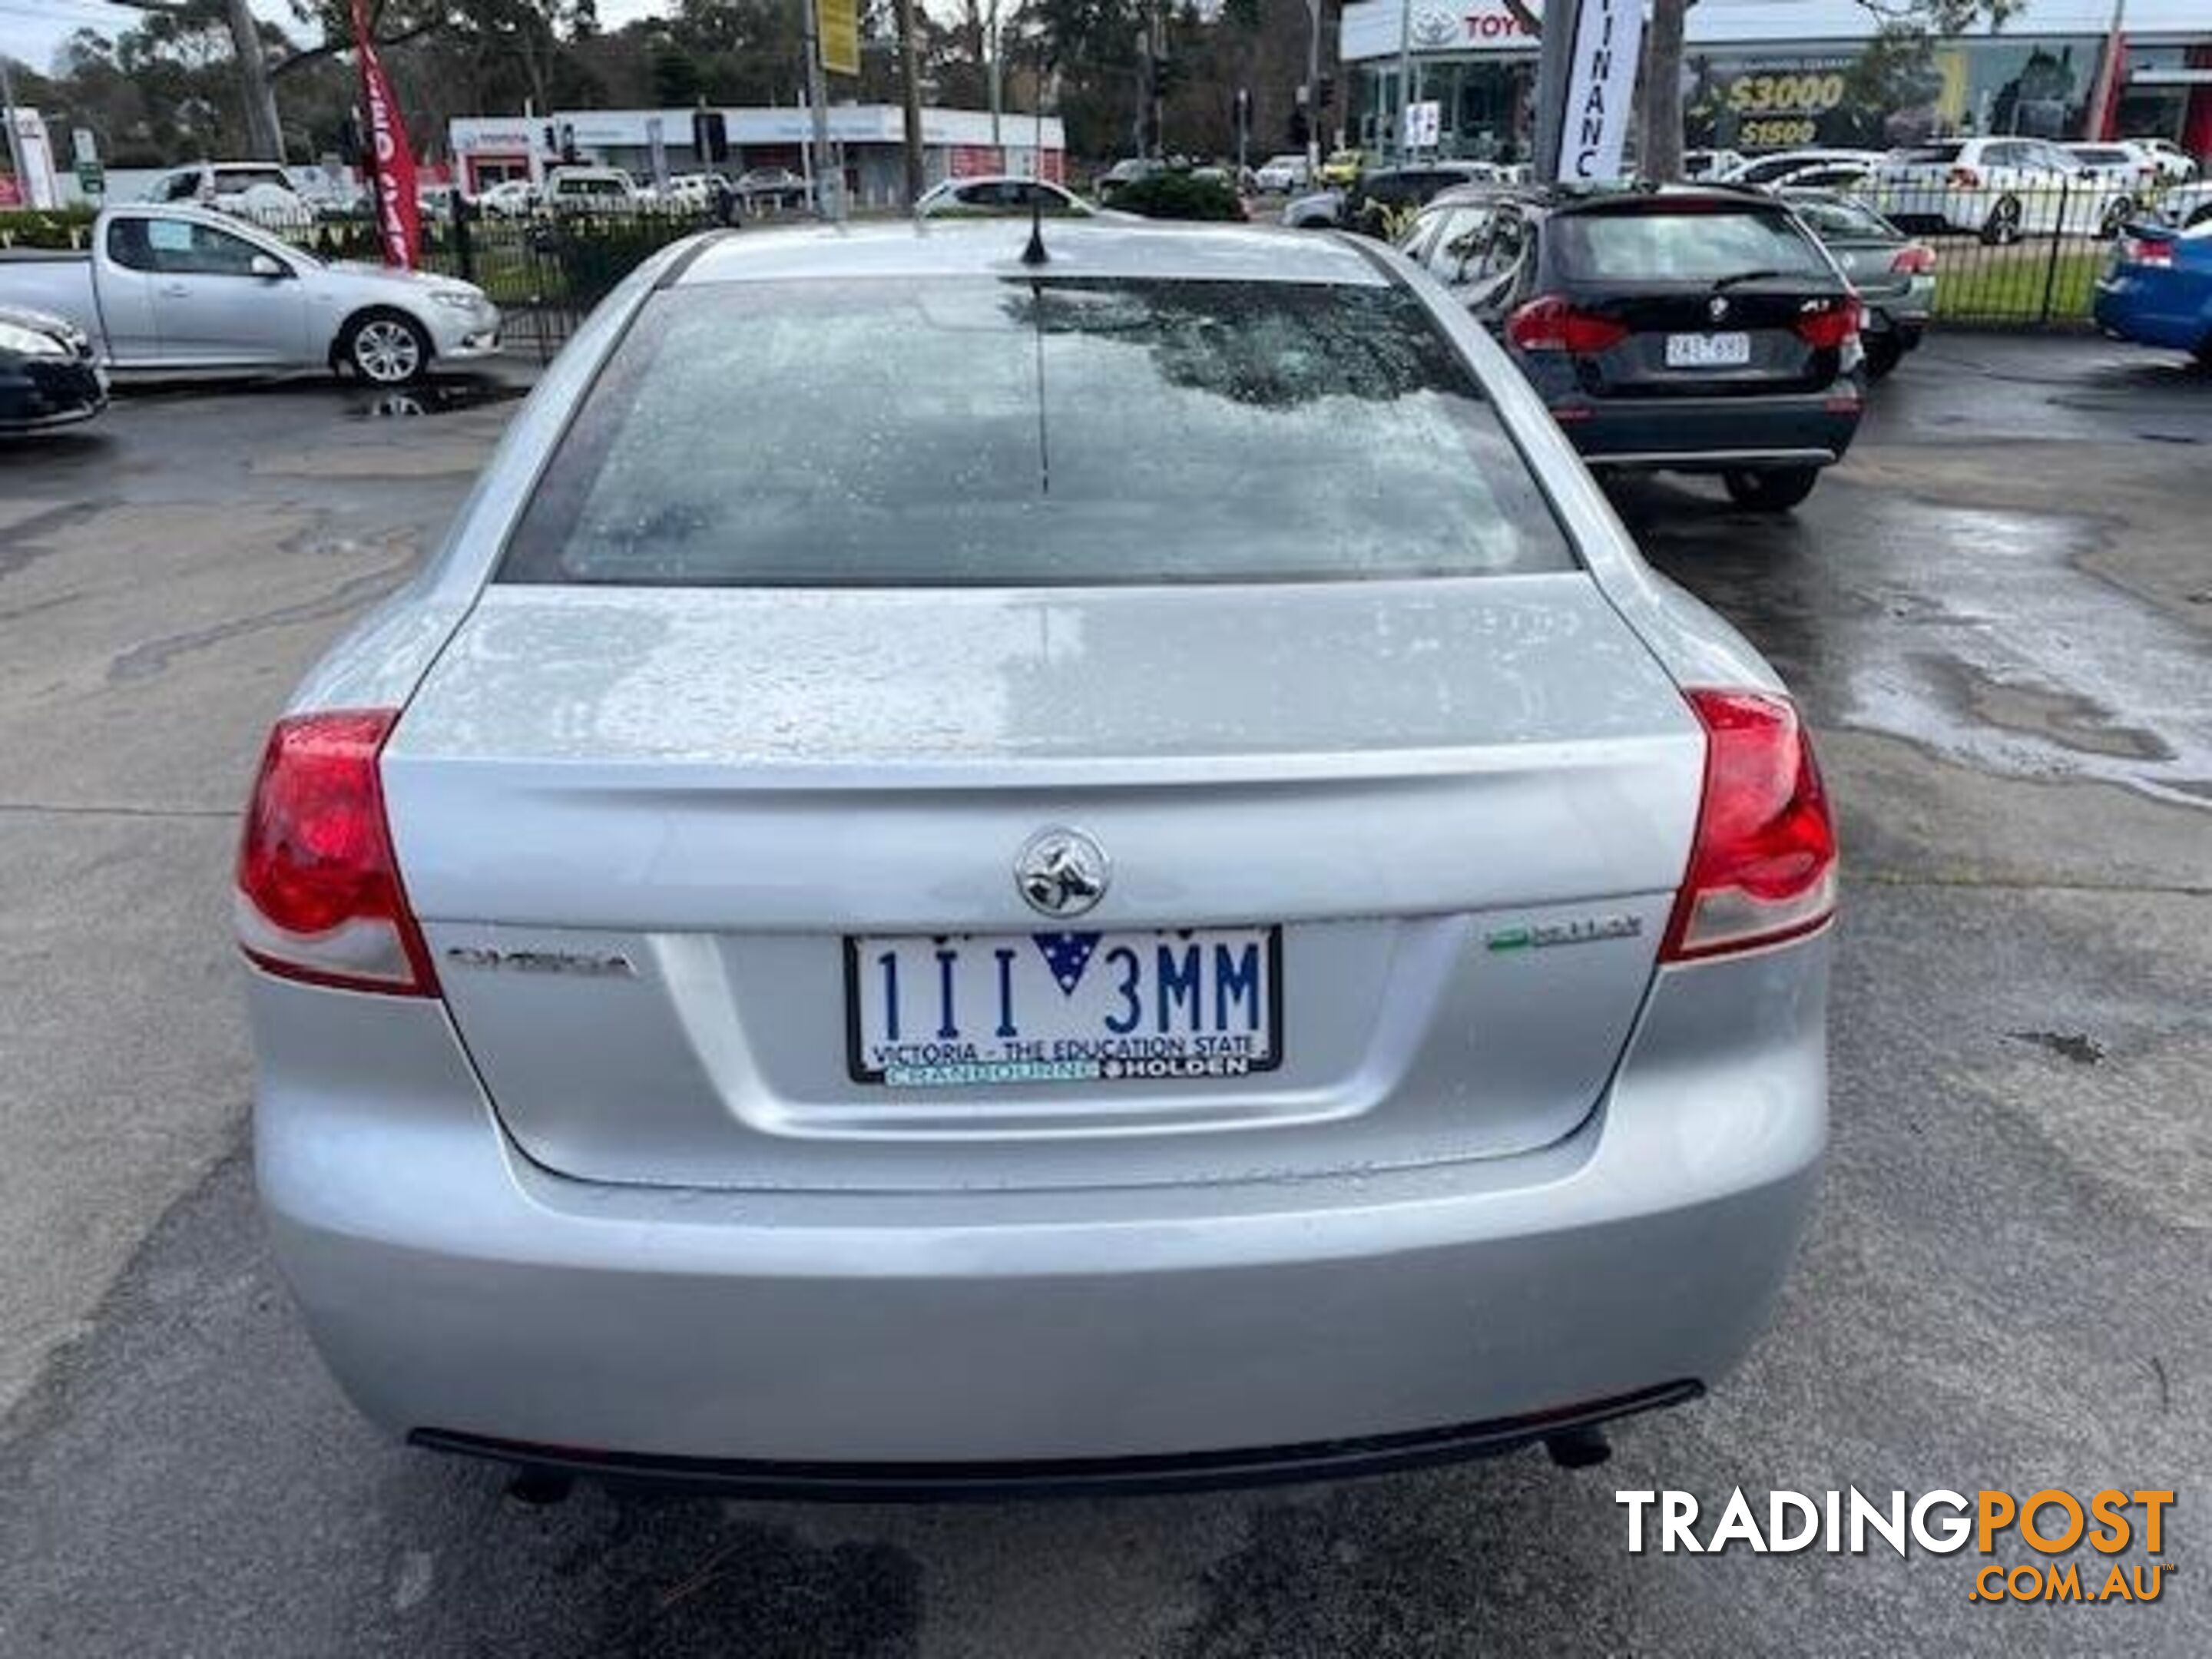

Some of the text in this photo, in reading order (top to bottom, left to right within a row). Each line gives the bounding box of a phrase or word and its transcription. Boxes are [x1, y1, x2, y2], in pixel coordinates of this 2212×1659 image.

[1575, 0, 1613, 177] INANC
[1105, 943, 1259, 1034] 3MM
[873, 1042, 978, 1065] VICTORIA
[1004, 1041, 1045, 1061] THE
[1053, 1036, 1184, 1061] EDUCATION
[1195, 1035, 1253, 1055] STATE
[1126, 1058, 1249, 1077] HOLDEN
